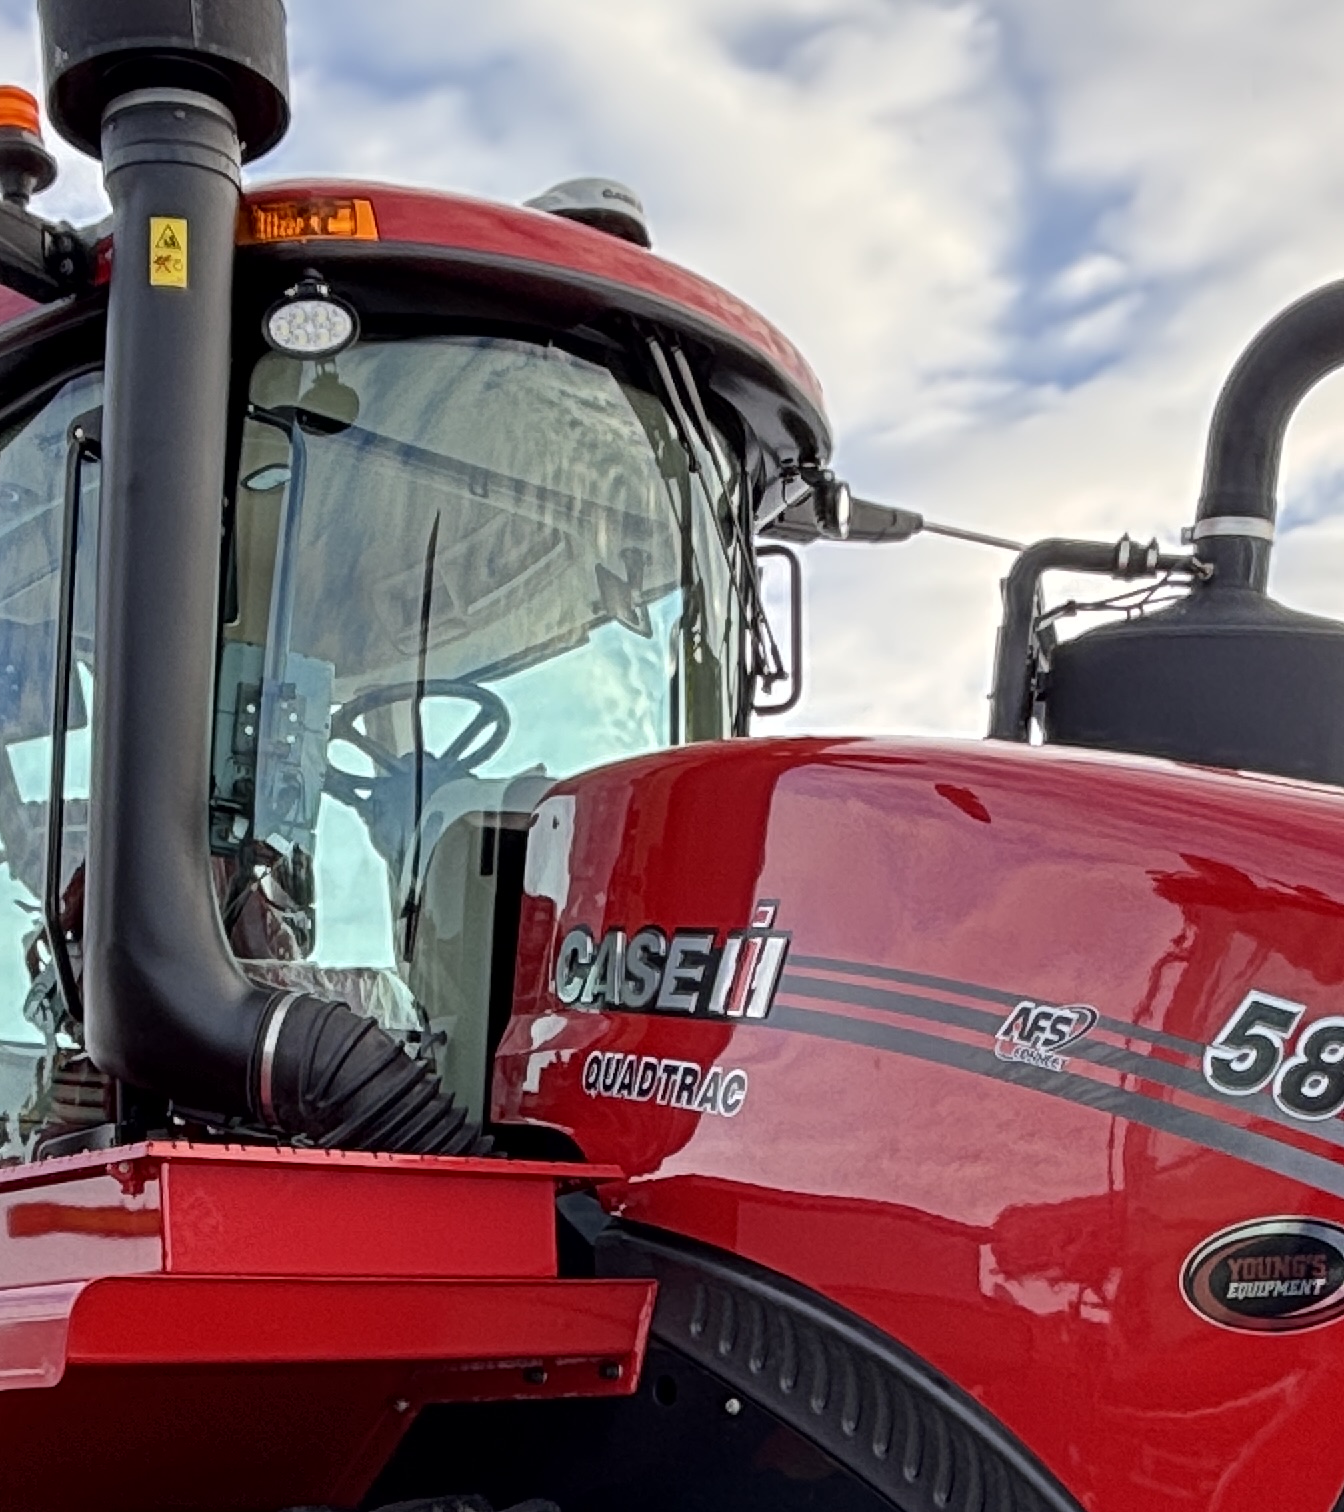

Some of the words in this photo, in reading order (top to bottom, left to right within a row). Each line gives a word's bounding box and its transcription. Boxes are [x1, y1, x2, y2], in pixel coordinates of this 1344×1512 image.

[555, 928, 716, 1014] CASE
[995, 1001, 1080, 1049] AFS
[582, 1050, 749, 1117] QUADTRAC
[1226, 1278, 1327, 1300] EQUIPMENT
[1227, 1254, 1327, 1282] YOUNG'S
